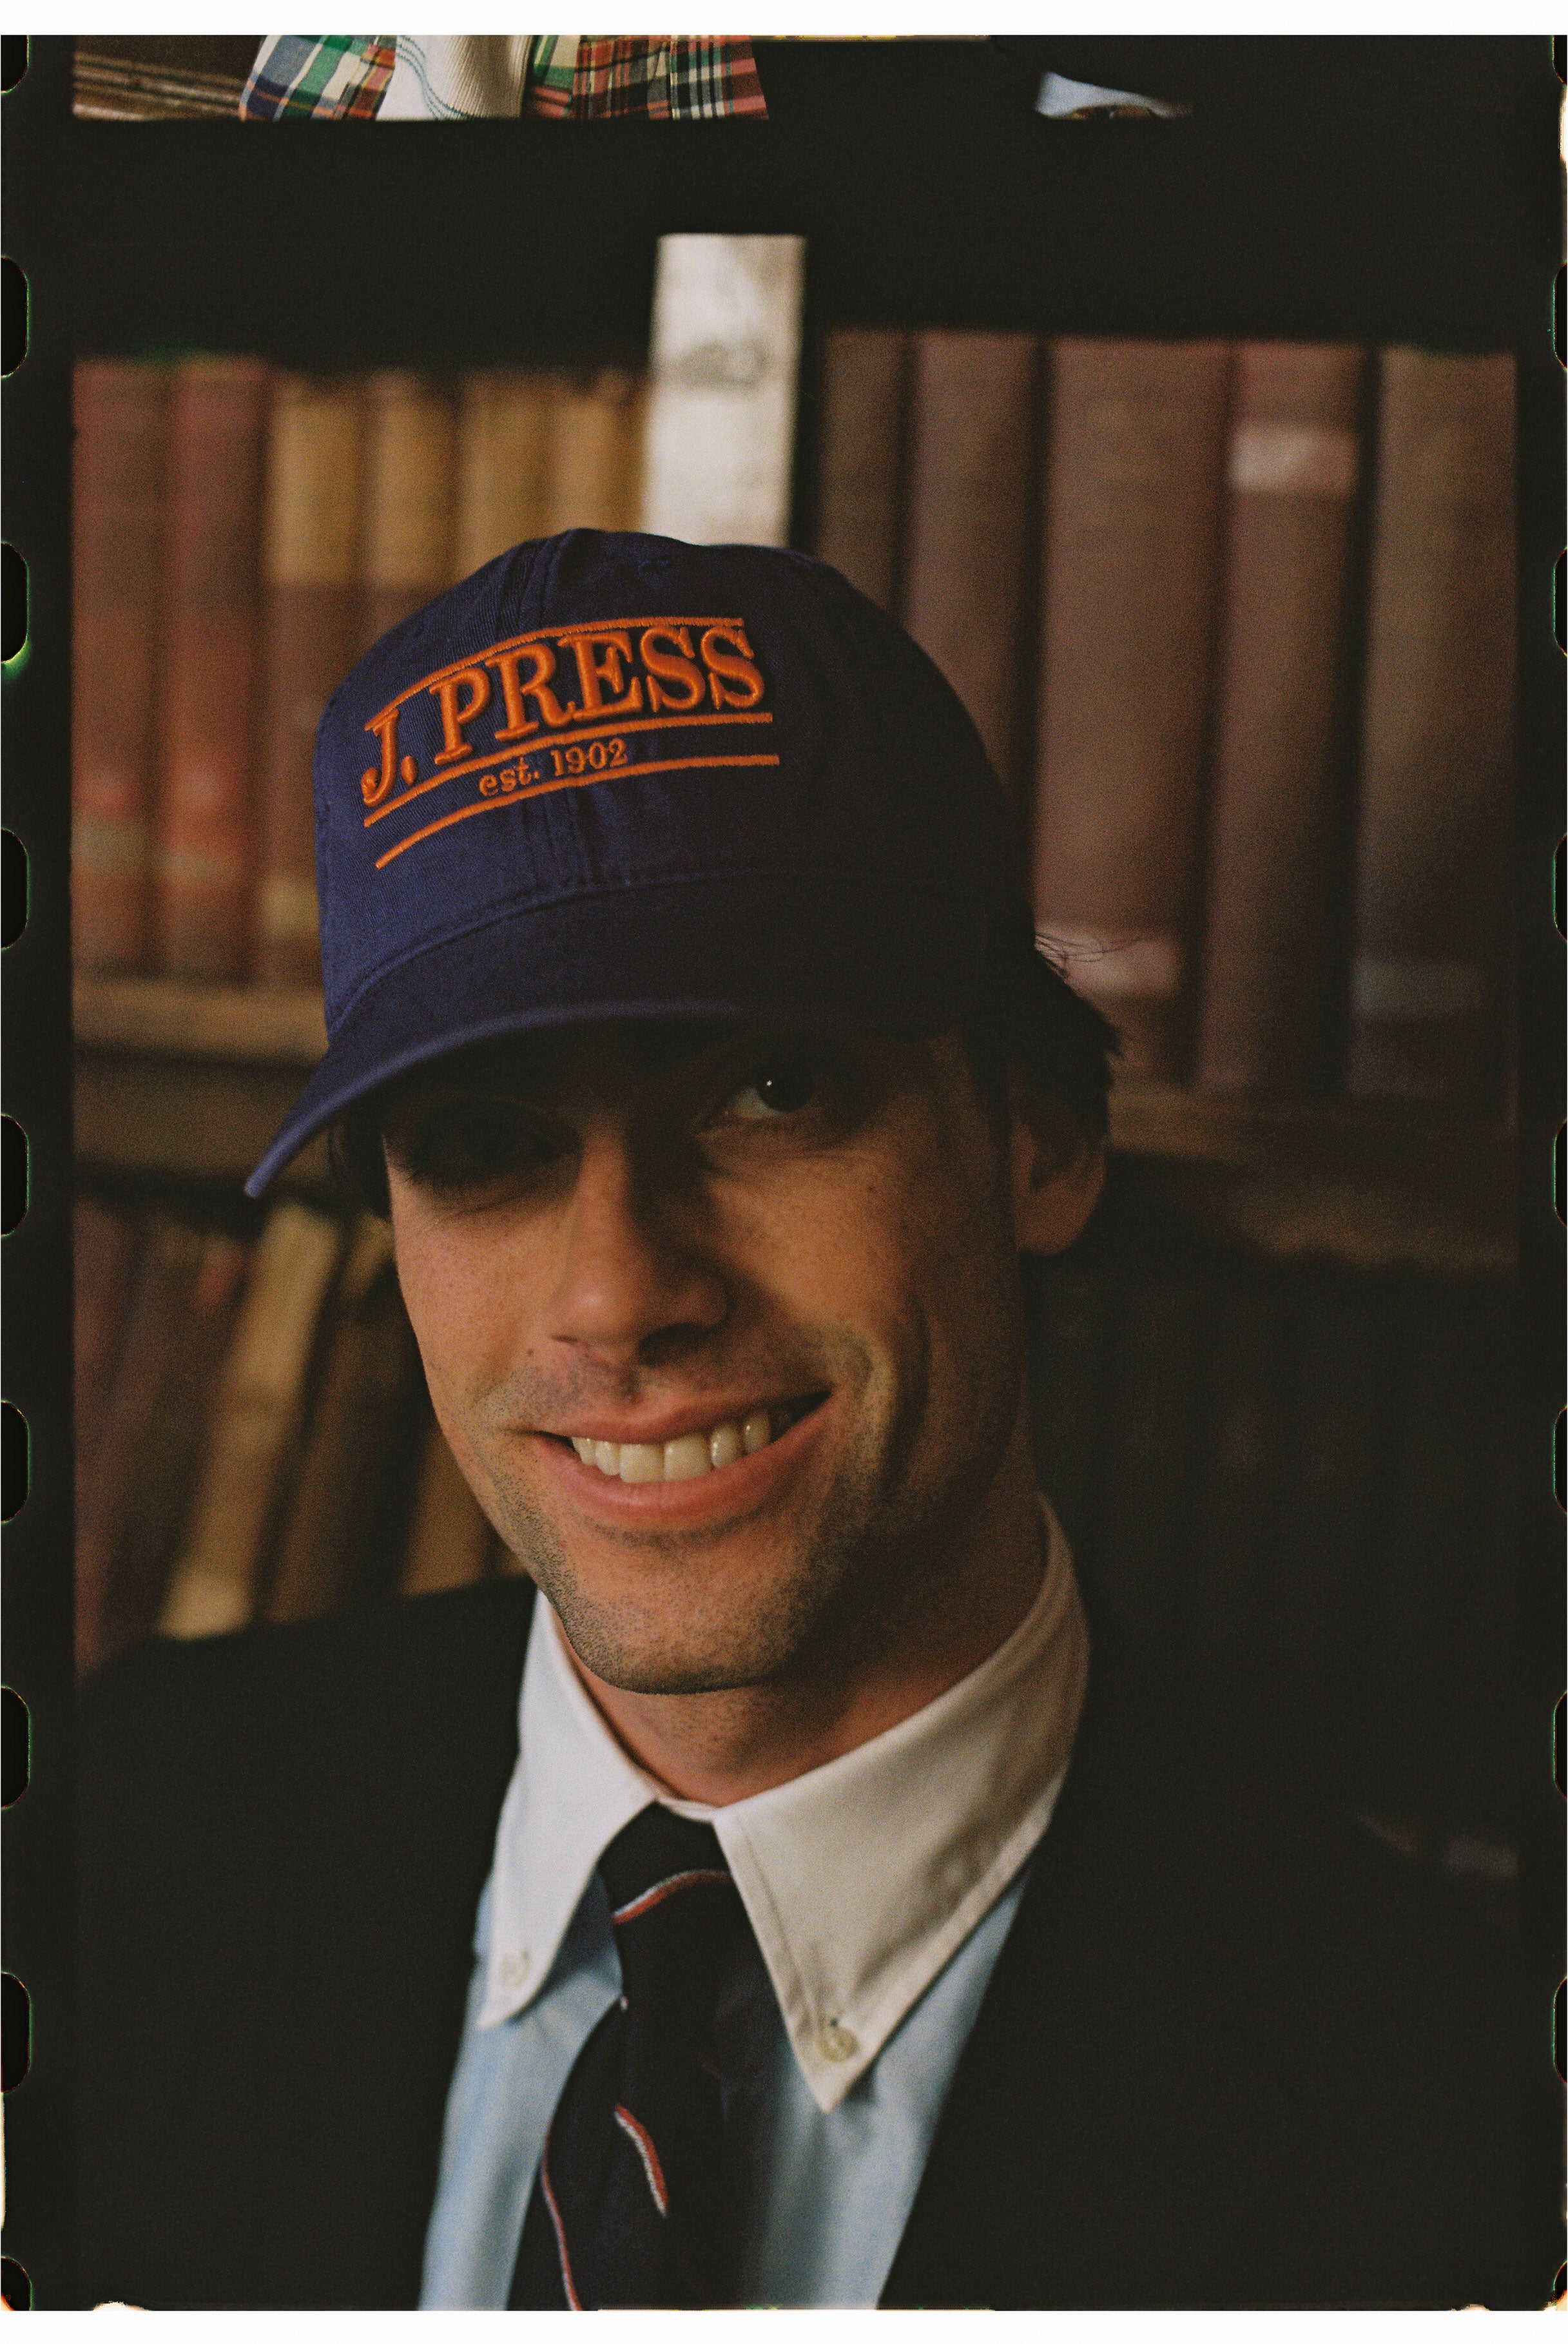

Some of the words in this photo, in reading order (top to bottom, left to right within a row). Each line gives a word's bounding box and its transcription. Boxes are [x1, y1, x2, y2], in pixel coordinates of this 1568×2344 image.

[360, 710, 416, 807] J.
[430, 626, 764, 765] PRESS
[479, 755, 540, 797] est.
[550, 737, 628, 777] 1902
